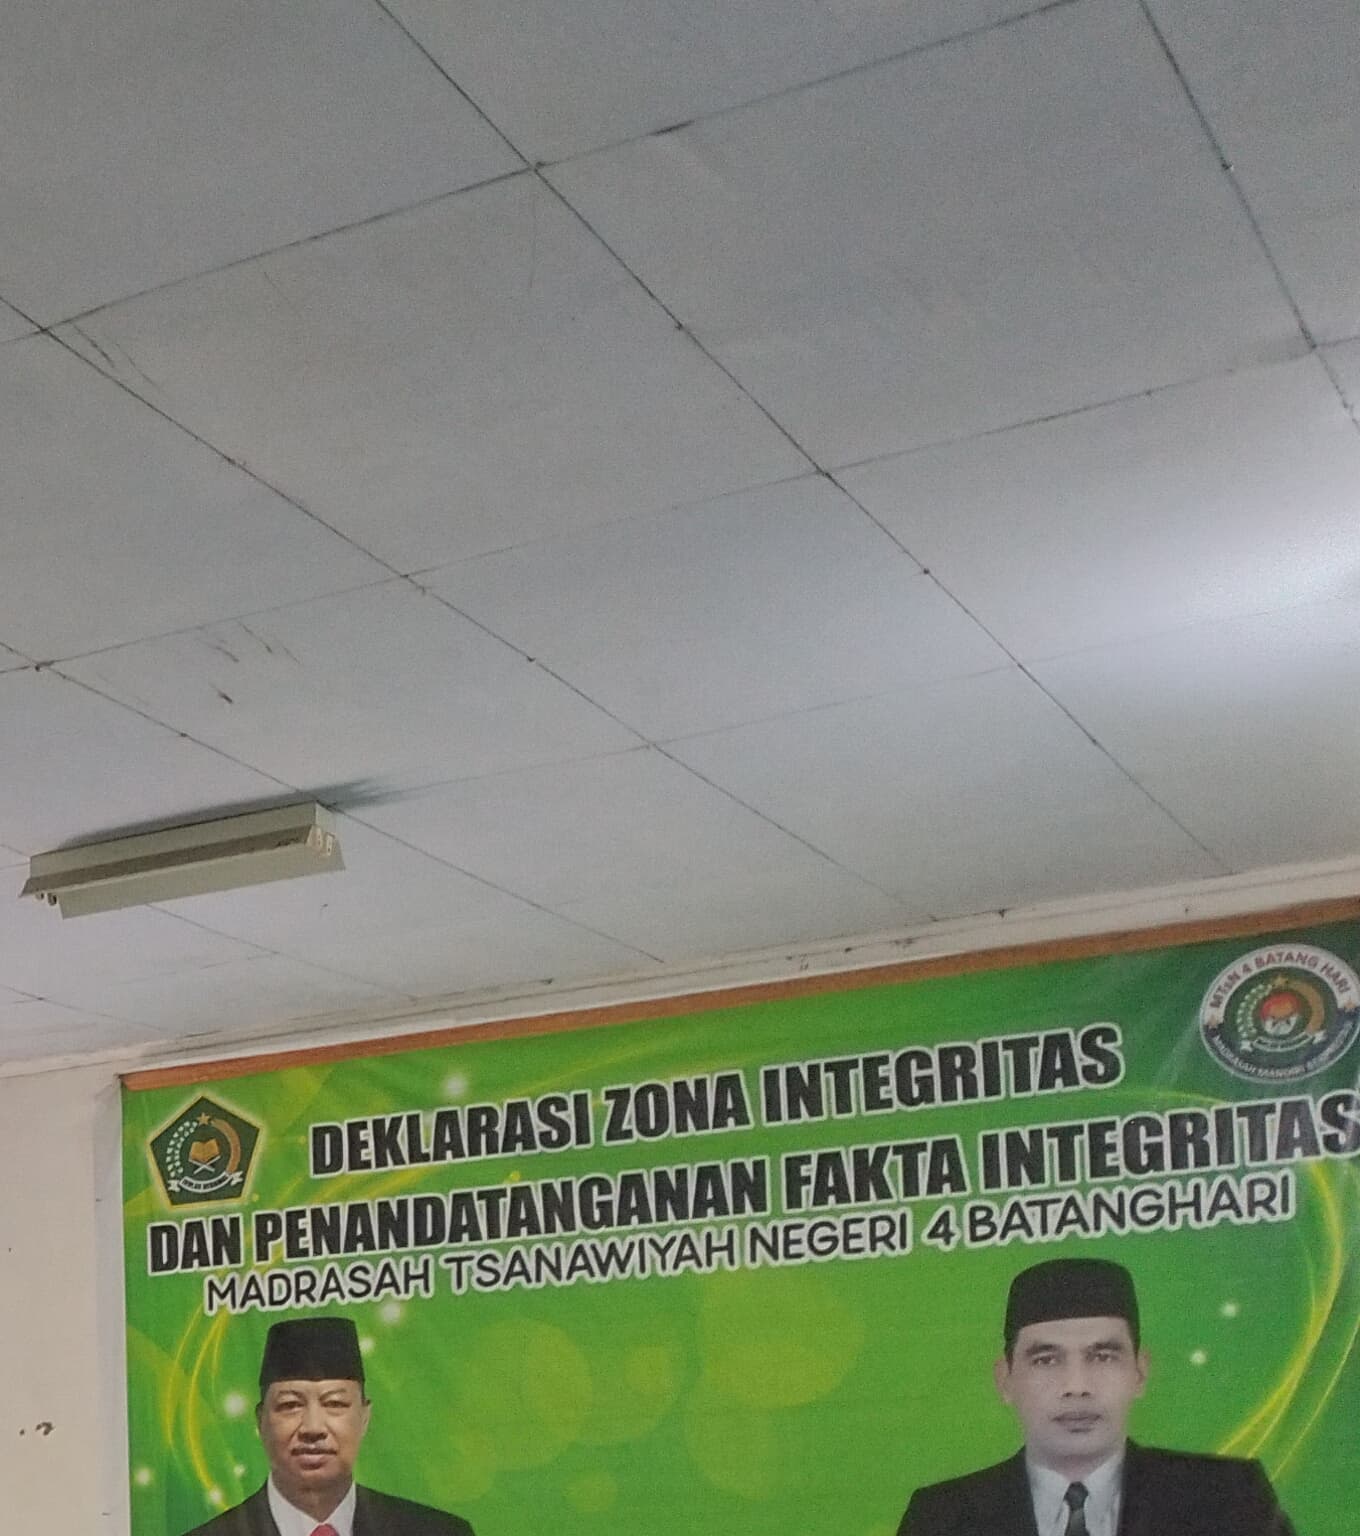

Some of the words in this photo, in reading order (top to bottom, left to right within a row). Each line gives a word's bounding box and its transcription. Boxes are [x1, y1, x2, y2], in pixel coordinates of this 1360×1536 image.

[1254, 951, 1320, 969] BATANG
[1320, 963, 1352, 994] HARI
[311, 1093, 589, 1176] DEKLARASI
[604, 1073, 750, 1143] ZONA
[763, 1025, 1122, 1122] INTEGRITAS
[148, 1218, 242, 1274] DAN
[255, 1159, 768, 1262] PENANDATANGANAN
[785, 1139, 968, 1210] FAKTA
[982, 1093, 1360, 1190] INTEGRITAS
[206, 1258, 430, 1313] MADRASAH
[447, 1231, 735, 1290] TSANAWIYAH
[750, 1219, 909, 1259] NEGERI
[927, 1211, 957, 1248] 4
[969, 1175, 1291, 1243] BATANGHARI
